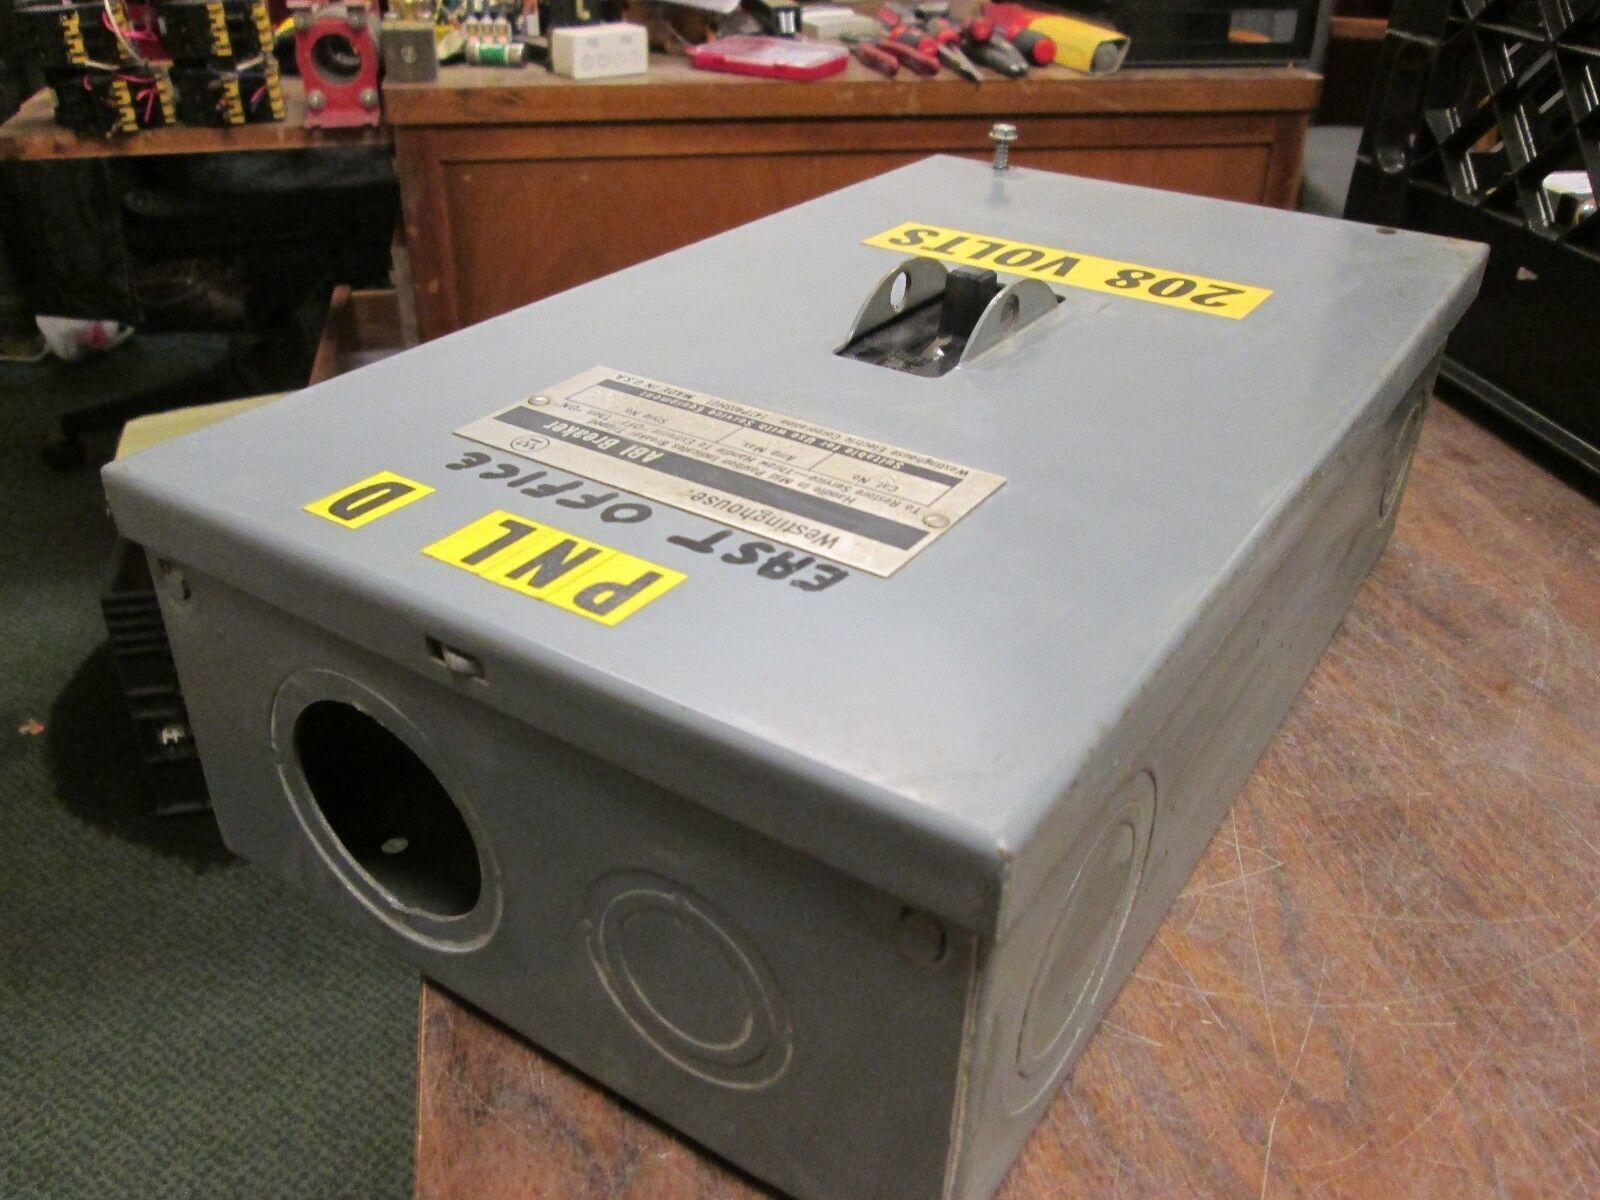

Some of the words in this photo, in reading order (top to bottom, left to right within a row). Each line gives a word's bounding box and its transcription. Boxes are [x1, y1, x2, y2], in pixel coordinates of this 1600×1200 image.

[889, 228, 1081, 278] VOLTS
[1104, 269, 1247, 308] 208
[543, 421, 621, 449] Breaker
[328, 481, 416, 518] D
[445, 451, 652, 524] OFFICE
[461, 519, 664, 616] PNL
[667, 529, 849, 592] EAST
